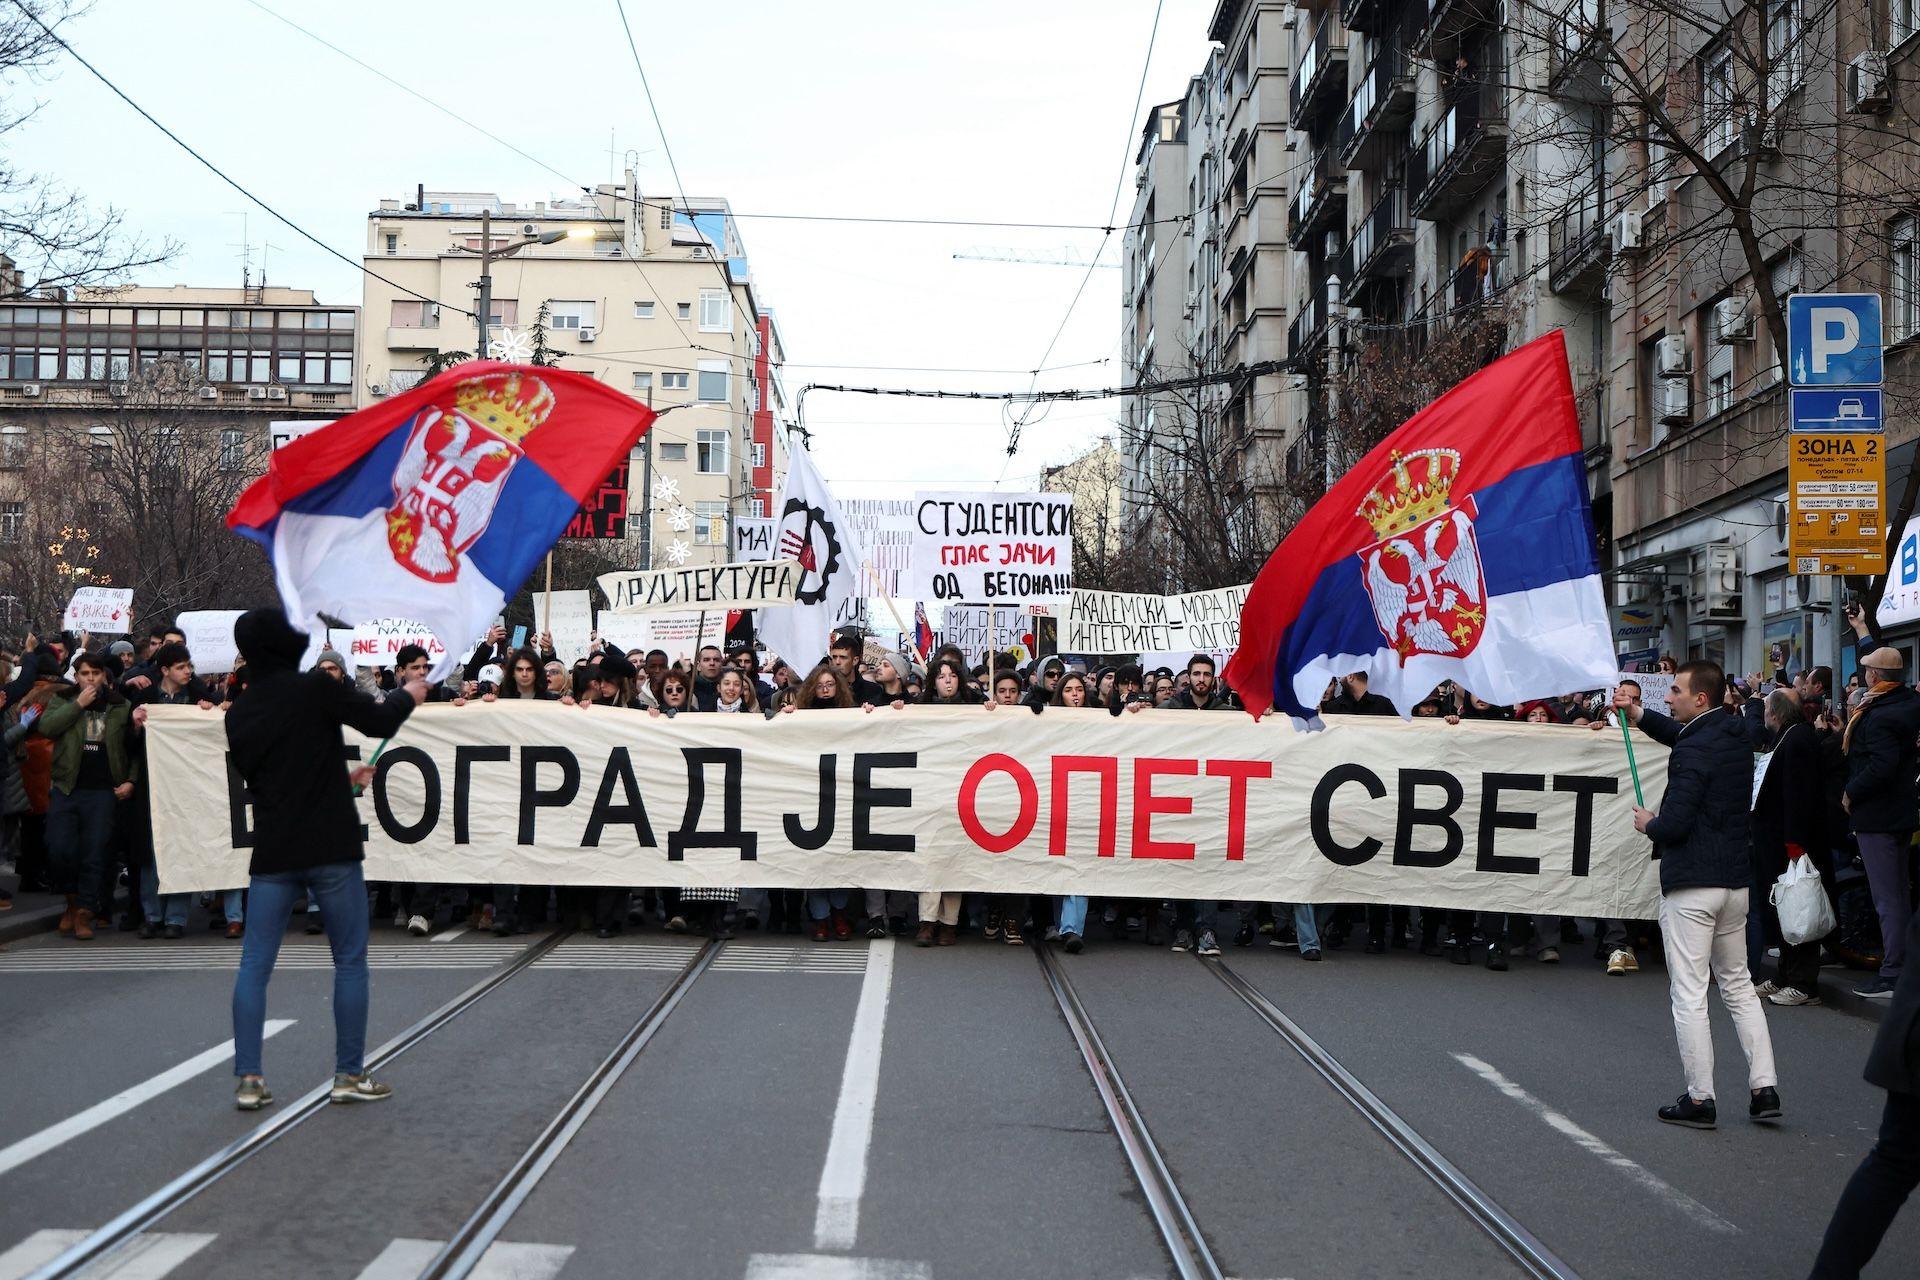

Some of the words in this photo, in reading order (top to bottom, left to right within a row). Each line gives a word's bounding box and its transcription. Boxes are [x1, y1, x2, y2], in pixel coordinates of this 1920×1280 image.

[1798, 439, 1856, 455] ЗОНА
[1866, 439, 1877, 454] 2
[917, 499, 1073, 536] СТУДЕНТСКИ
[941, 544, 990, 566] ГЛАС
[999, 543, 1055, 566] ЈАЧИ
[932, 572, 964, 599] ОД
[983, 571, 1071, 597] БЕТОНА!!!
[949, 610, 969, 626] МИ
[1070, 591, 1169, 624] АКАДЕМСКИ
[1070, 622, 1171, 651] ИНТЕГРИТЕТ
[1189, 620, 1241, 650] ОДГОВ
[1617, 626, 1653, 636] ПОШТА
[225, 745, 757, 861] ОГРАД
[782, 752, 918, 852] ЈЕ
[957, 752, 1272, 861] ОПЕТ
[1310, 762, 1619, 877] СВЕТ
